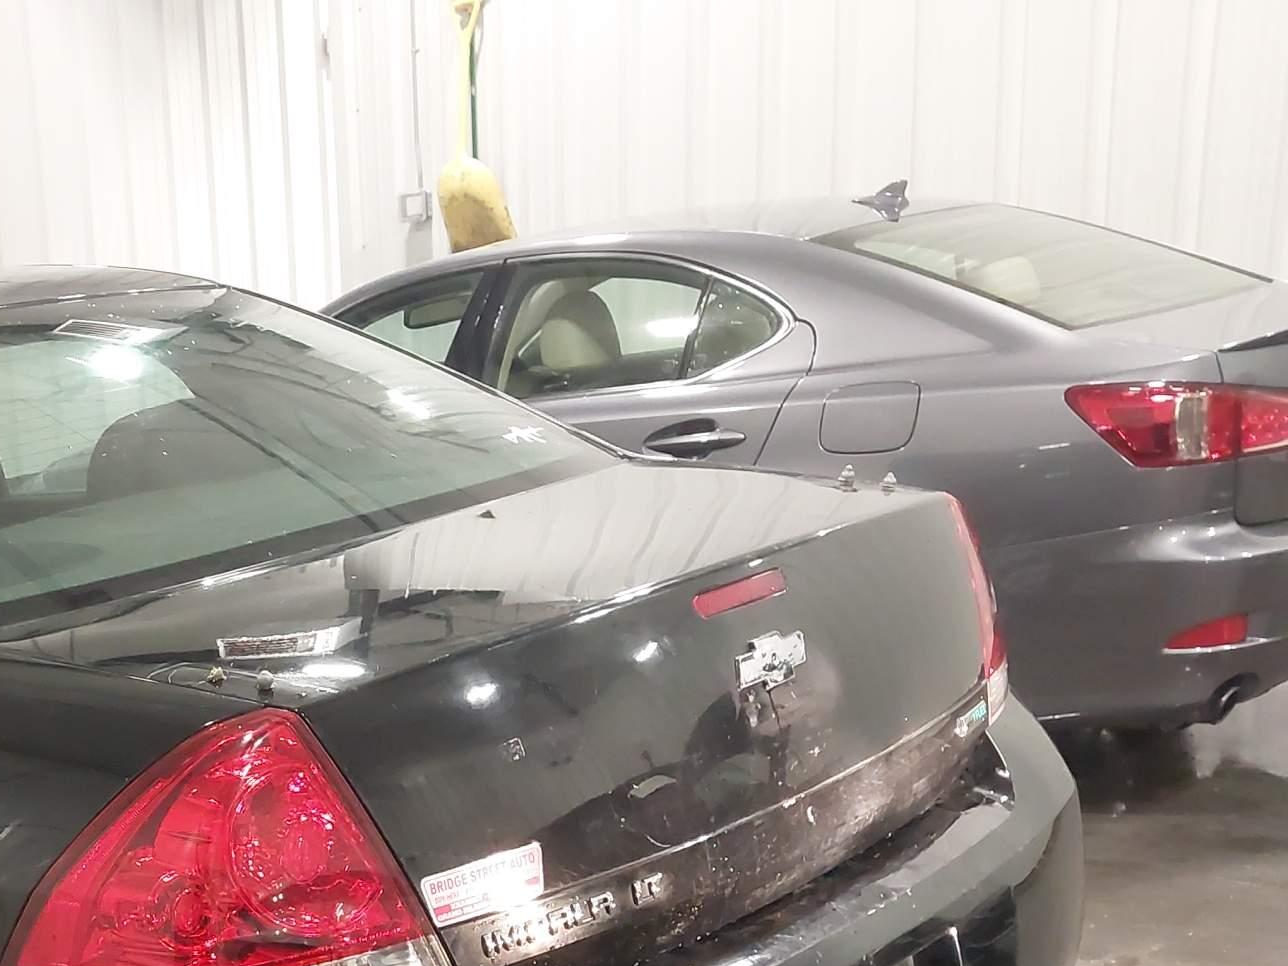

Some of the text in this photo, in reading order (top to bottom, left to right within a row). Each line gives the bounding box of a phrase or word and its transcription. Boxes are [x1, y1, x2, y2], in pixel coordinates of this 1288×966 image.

[429, 873, 468, 895] BRIDGE
[470, 861, 507, 884] STREET
[510, 851, 535, 870] AUTO
[630, 871, 663, 906] LT
